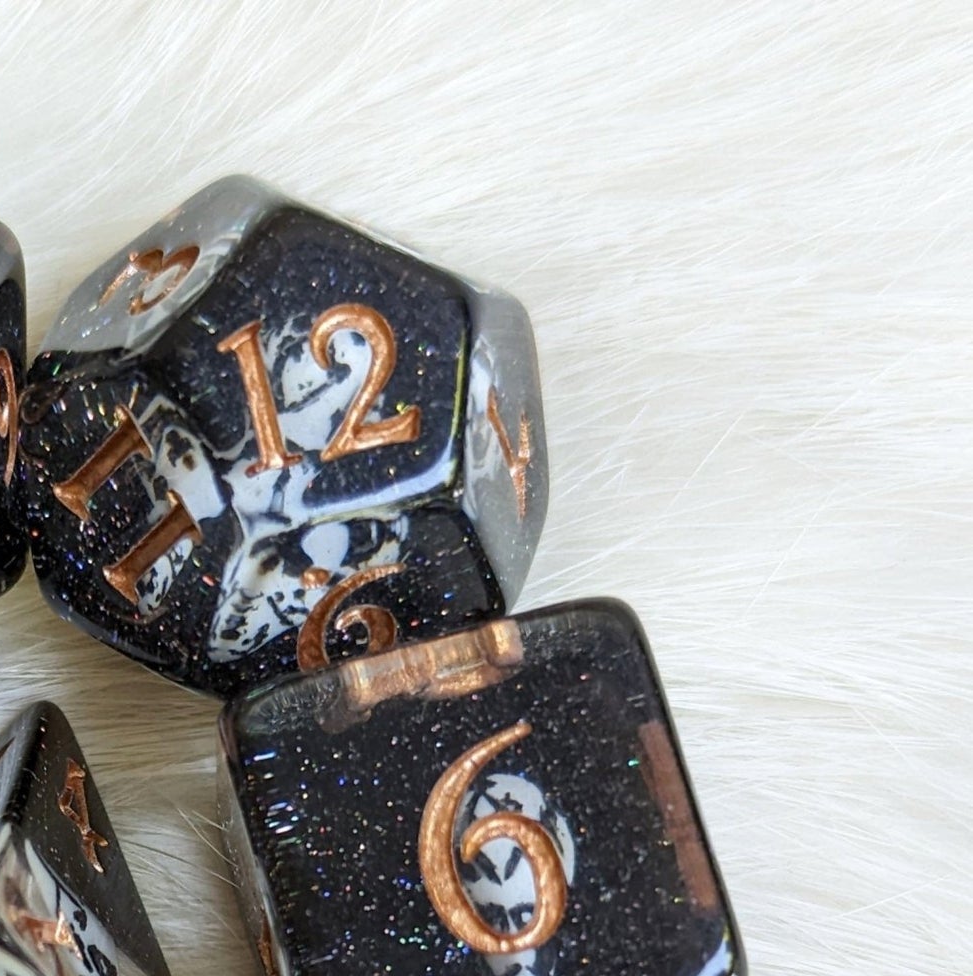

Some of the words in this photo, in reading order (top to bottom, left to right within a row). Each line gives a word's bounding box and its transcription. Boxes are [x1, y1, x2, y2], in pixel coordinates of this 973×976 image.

[217, 303, 422, 478] 12
[52, 403, 203, 605] 11
[418, 721, 570, 955] 6
